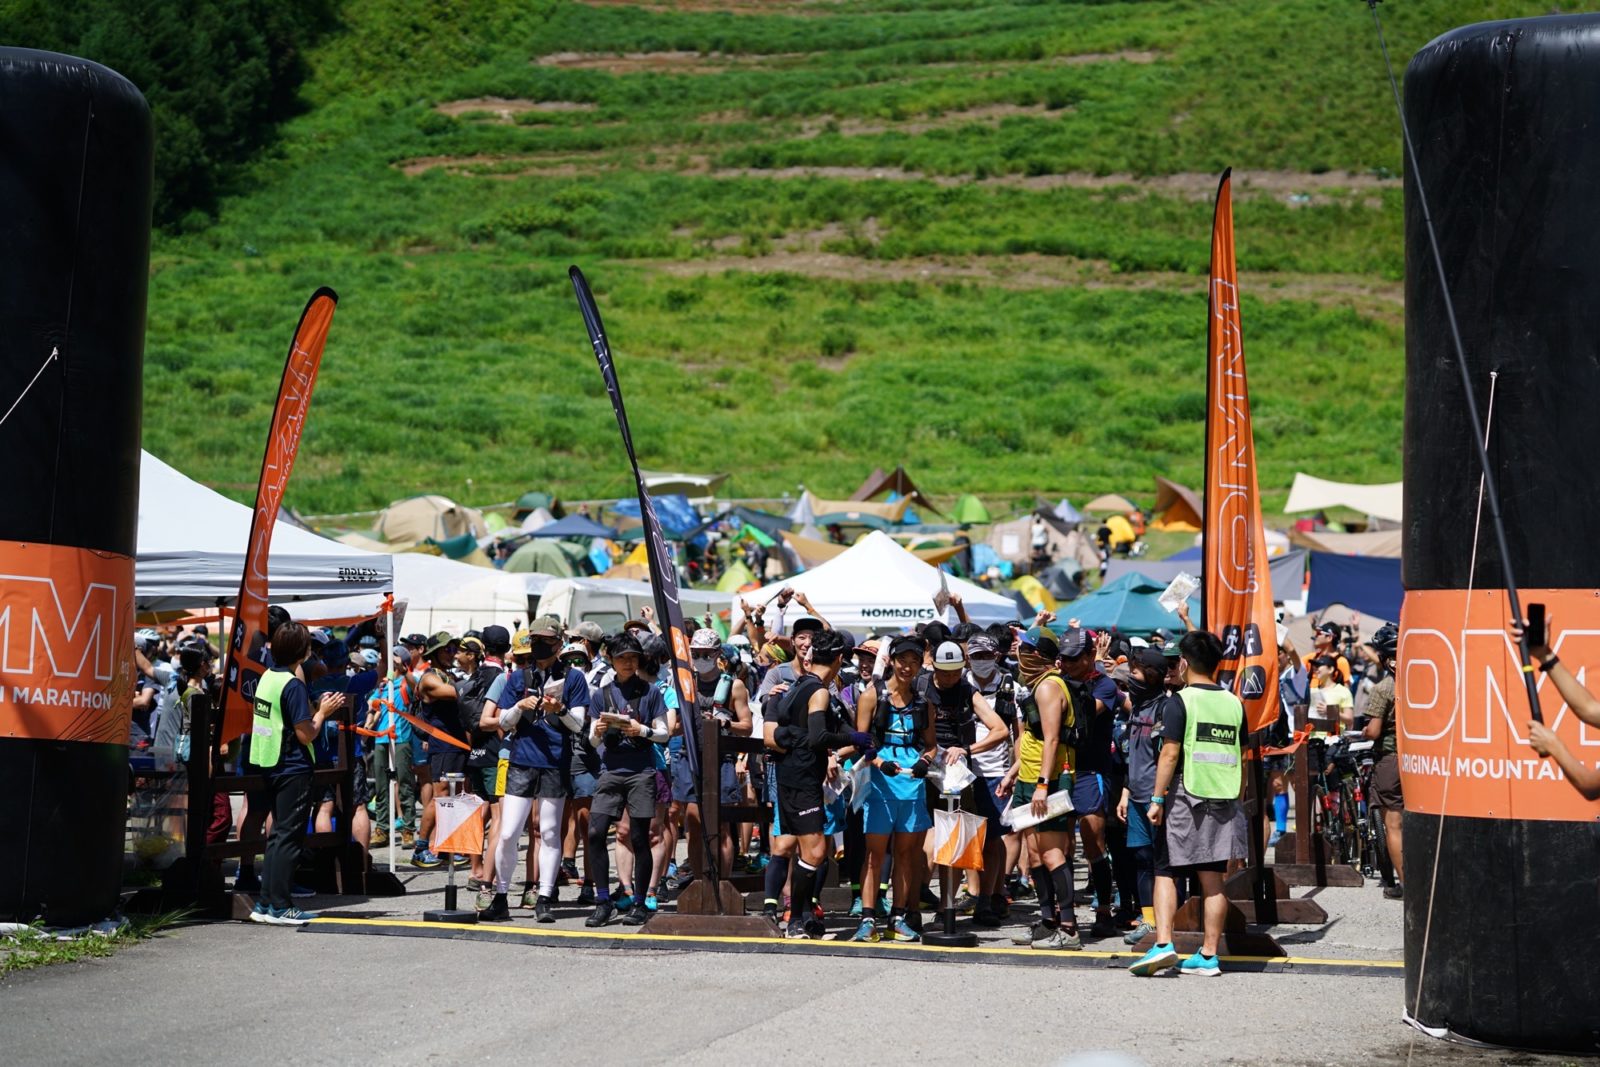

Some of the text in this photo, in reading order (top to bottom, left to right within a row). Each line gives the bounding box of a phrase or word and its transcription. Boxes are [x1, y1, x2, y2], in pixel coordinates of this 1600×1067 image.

[861, 608, 935, 619] NOMADICS
[12, 686, 113, 710] MARATHON
[1211, 727, 1235, 740] OMM
[1401, 753, 1585, 781] ORIGINAL MOUNTAI
